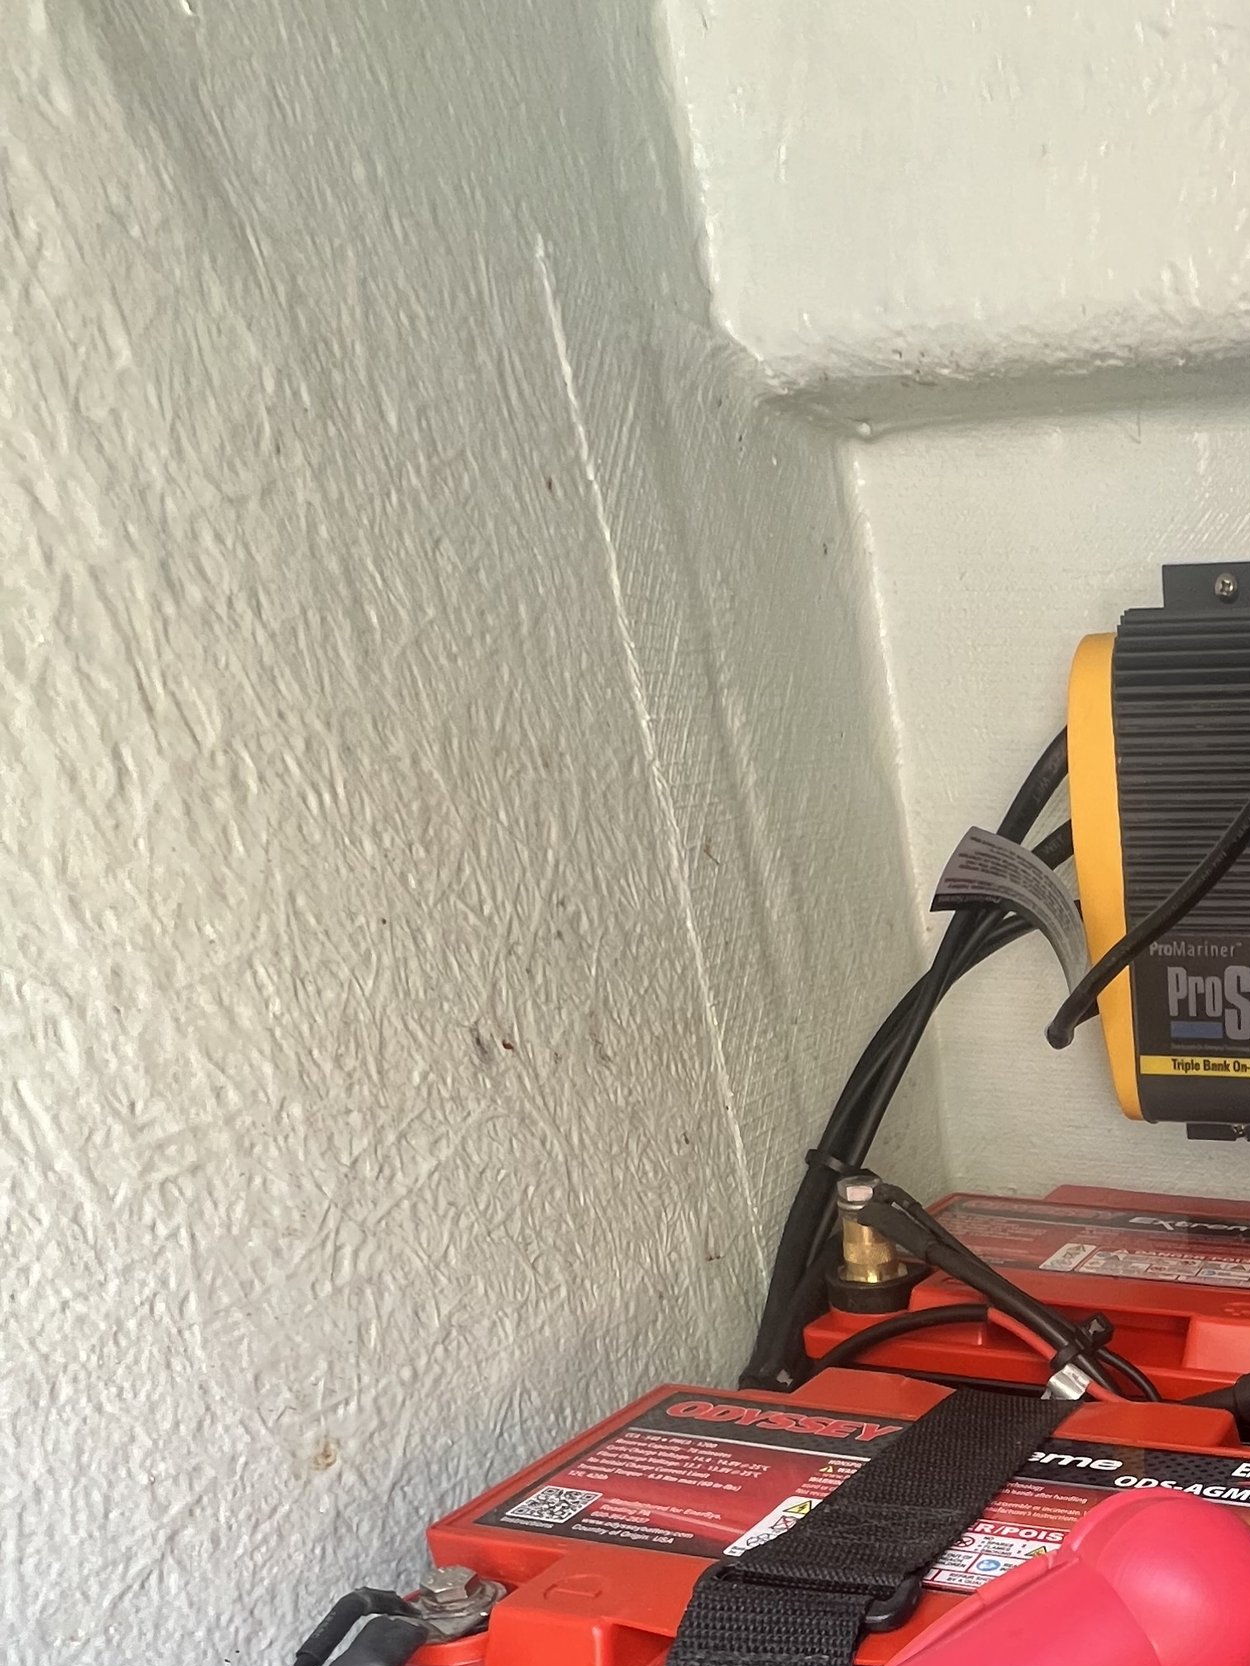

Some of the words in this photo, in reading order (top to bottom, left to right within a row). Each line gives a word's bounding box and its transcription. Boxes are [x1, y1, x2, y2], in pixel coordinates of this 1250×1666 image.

[1171, 1059, 1200, 1072] Triple
[1203, 1060, 1230, 1072] Bank
[666, 1401, 903, 1441] ODYSSEY
[1035, 1492, 1052, 1500] after
[1052, 1494, 1088, 1504] handling
[499, 1515, 554, 1530] Instructions
[571, 1523, 608, 1536] Country
[652, 1536, 674, 1545] USA
